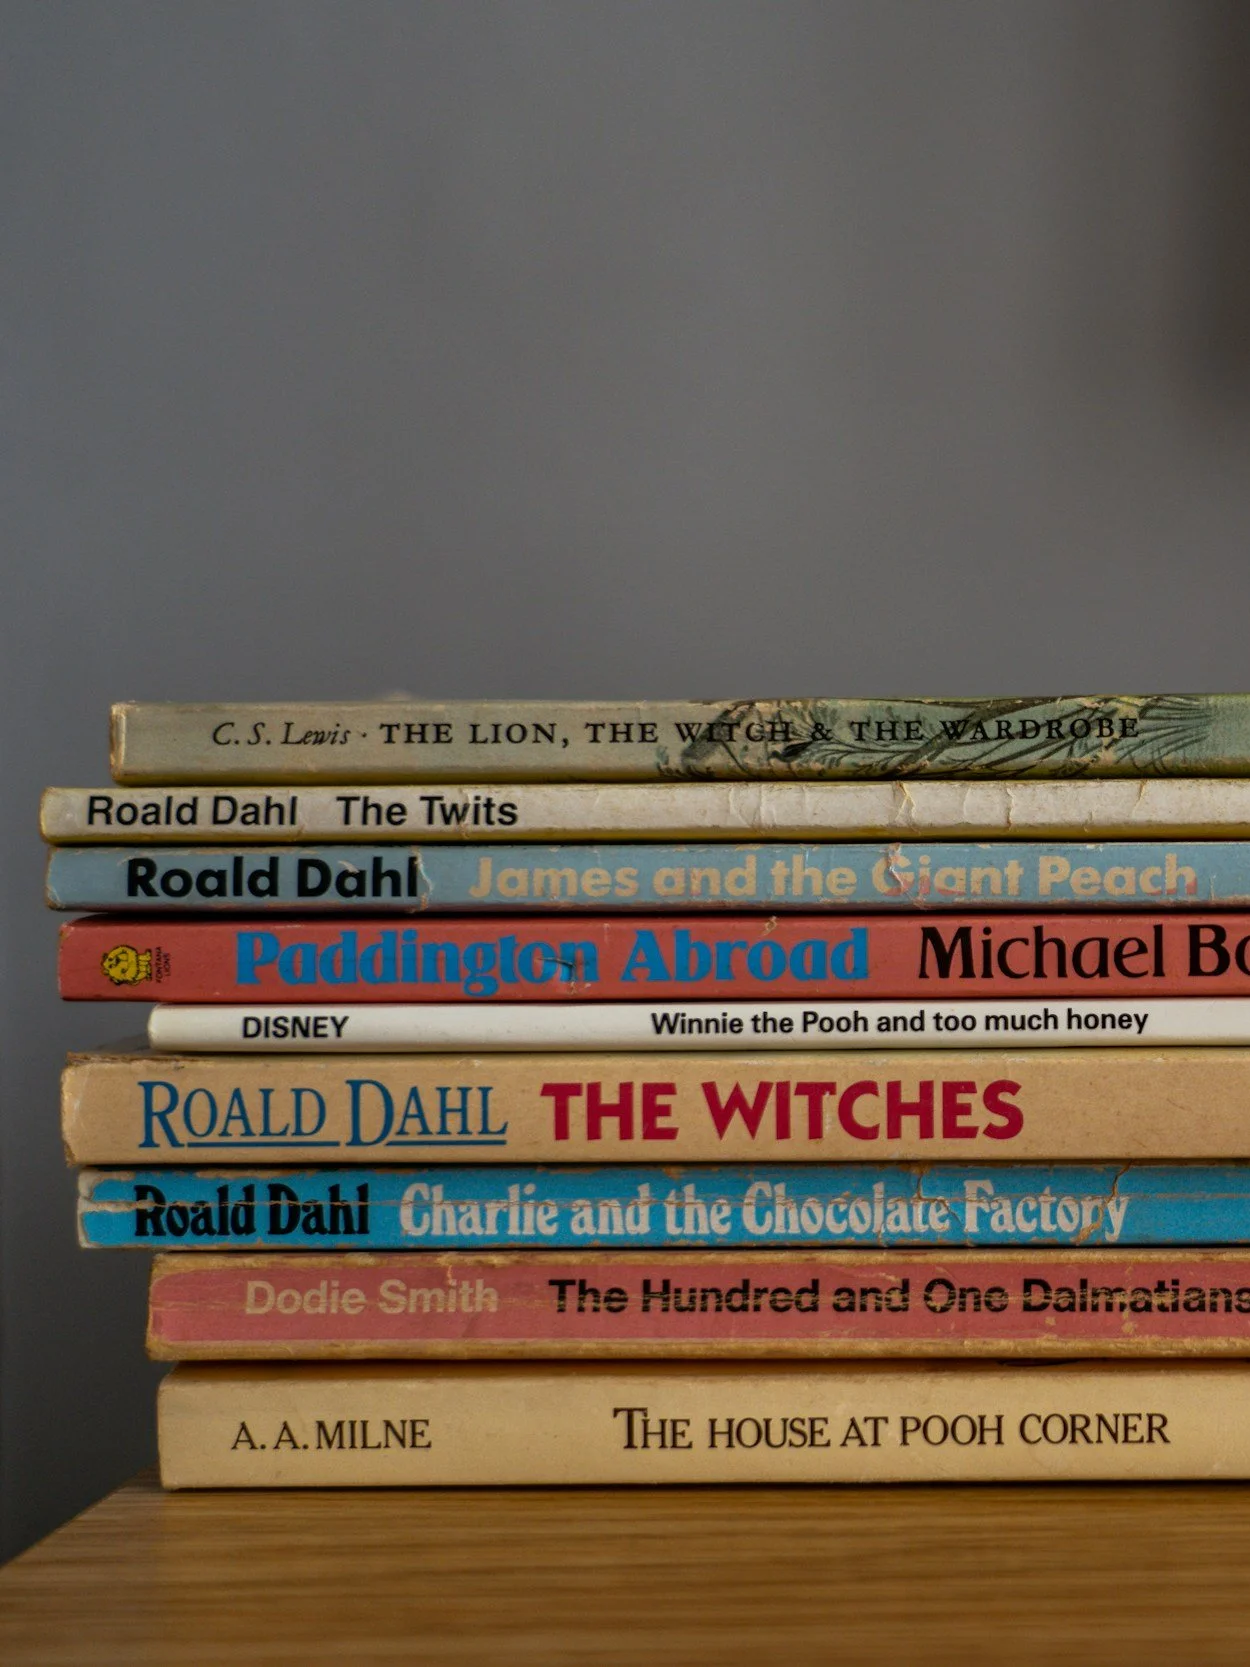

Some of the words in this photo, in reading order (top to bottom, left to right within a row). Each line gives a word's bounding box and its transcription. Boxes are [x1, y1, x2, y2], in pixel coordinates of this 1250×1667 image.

[281, 723, 352, 746] Lewis
[380, 723, 452, 745] THE
[469, 722, 570, 748] LION,
[585, 722, 658, 744] THE
[675, 722, 793, 744] WITCH
[810, 722, 832, 743] &
[850, 720, 924, 742] THE
[941, 717, 1140, 741] WARDROBE
[87, 796, 198, 826] Roald
[212, 796, 297, 826] Dahl
[336, 796, 407, 826] The
[420, 795, 518, 826] Twits
[127, 857, 279, 899] Roald
[297, 857, 418, 898] Dahl
[468, 857, 638, 900] James
[653, 854, 757, 897] and
[771, 853, 858, 897] the
[872, 854, 1025, 897] Giant
[1038, 853, 1197, 896] Peach
[236, 931, 598, 995] Paddington
[620, 928, 869, 981] Abroad
[919, 925, 1164, 979] Michael
[244, 1016, 349, 1039] DISNEY
[652, 1012, 744, 1035] Winnie
[751, 1012, 794, 1033] the
[803, 1011, 869, 1033] Pooh
[877, 1011, 925, 1033] and
[933, 1012, 977, 1032] too
[985, 1010, 1058, 1032] much
[1067, 1009, 1148, 1034] honey
[138, 1081, 327, 1148] ROALD
[345, 1079, 508, 1147] DAHL
[540, 1081, 679, 1140] THE
[702, 1080, 1024, 1140] WITCHES
[135, 1184, 257, 1237] Roald
[267, 1183, 370, 1235] Dahl
[400, 1183, 559, 1236] Charlie
[570, 1182, 653, 1237] and
[663, 1183, 732, 1236] the
[742, 1181, 953, 1235] Chocolate
[962, 1179, 1131, 1242] Factory
[245, 1280, 367, 1315] Dodie
[379, 1279, 500, 1315] Smith
[549, 1279, 629, 1313] The
[641, 1279, 820, 1313] Hundred
[832, 1279, 909, 1312] and
[923, 1278, 1008, 1312] One
[614, 1406, 694, 1450] THE
[709, 1416, 831, 1449] HOUSE
[840, 1416, 888, 1447] AT
[900, 1414, 1004, 1446] POOH
[1019, 1413, 1170, 1445] CORNER
